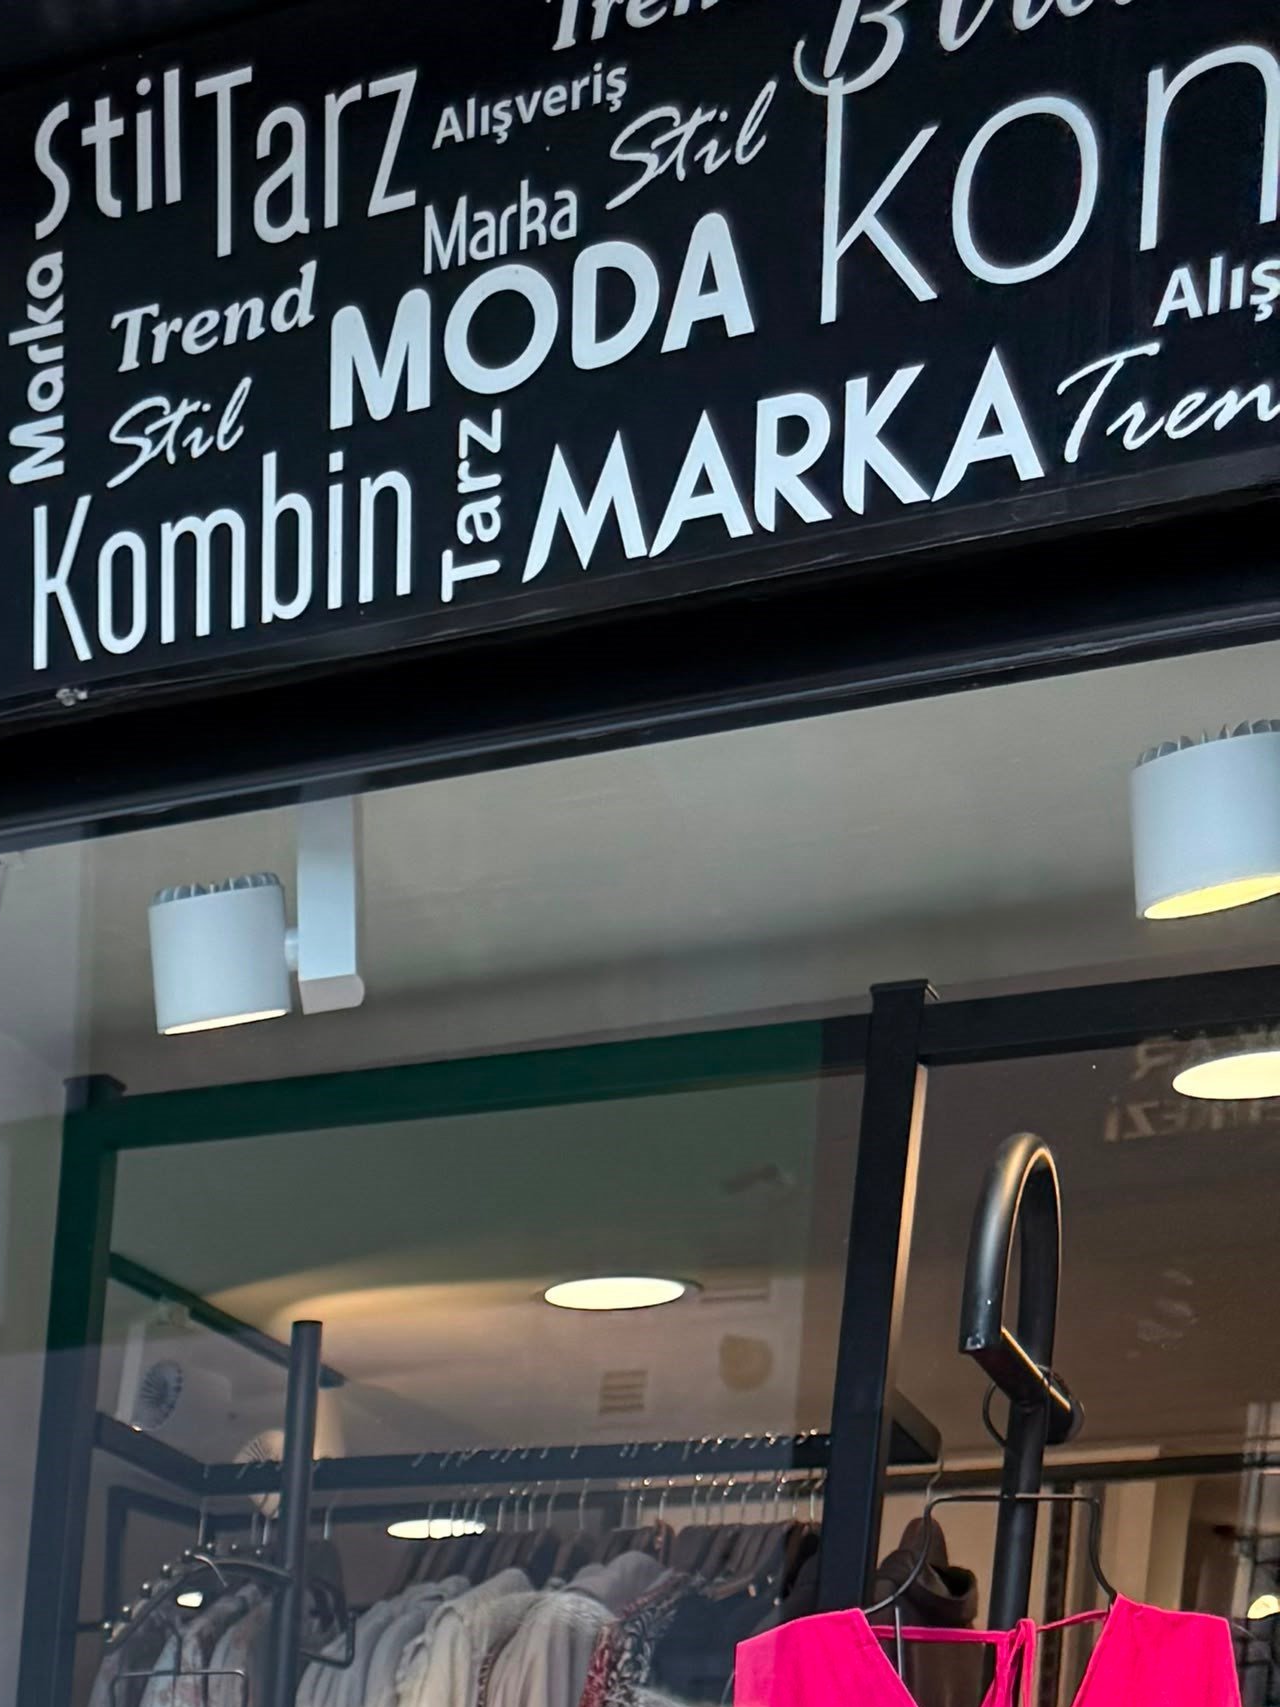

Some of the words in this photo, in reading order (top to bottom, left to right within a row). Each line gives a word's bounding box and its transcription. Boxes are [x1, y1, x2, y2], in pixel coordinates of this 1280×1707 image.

[34, 68, 180, 239] Stil
[195, 66, 416, 257] Tarz
[432, 62, 626, 145] Alışveriş
[605, 80, 776, 209] Stil
[819, 44, 1280, 326] kon
[111, 259, 316, 372] Trend
[329, 211, 754, 429] MODA
[423, 179, 577, 274] Marka
[8, 251, 64, 484] Marka
[106, 376, 251, 488] Stil
[33, 450, 411, 670] Kombin
[441, 408, 501, 602] Tarz
[521, 346, 1045, 583] MARKA
